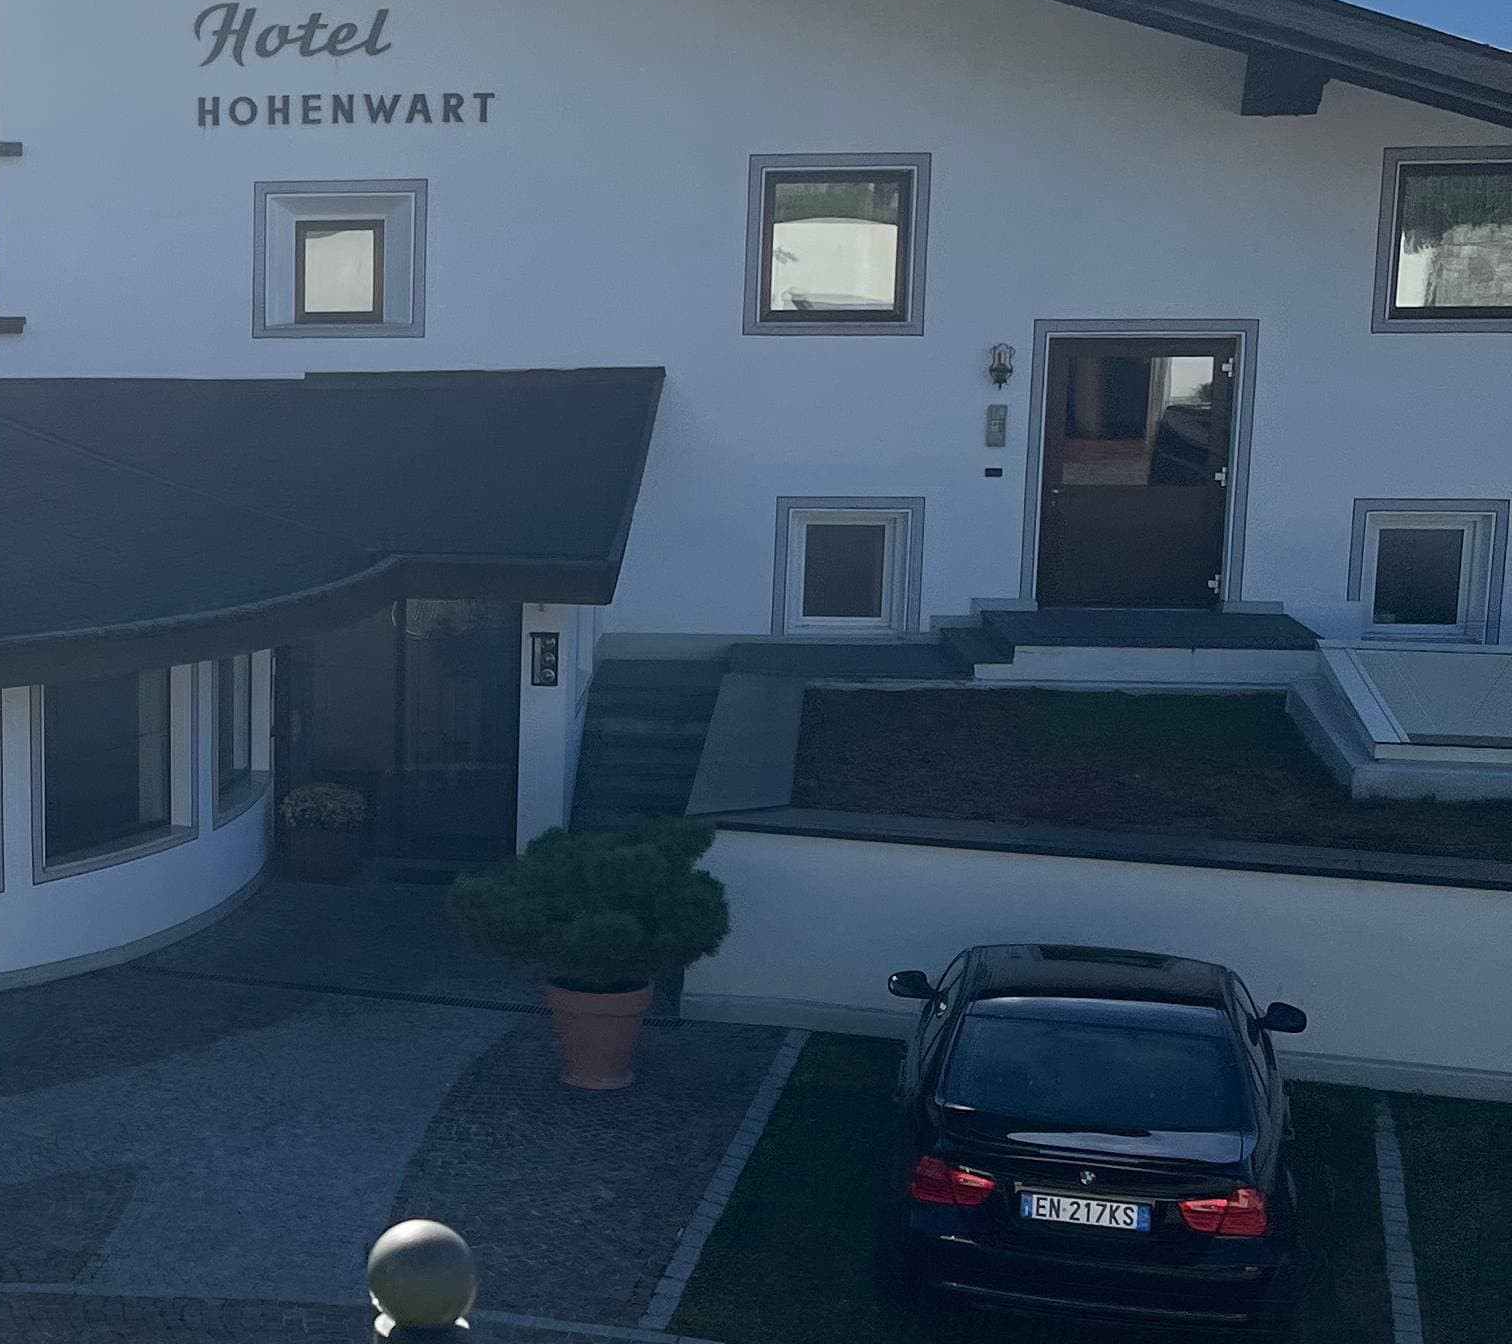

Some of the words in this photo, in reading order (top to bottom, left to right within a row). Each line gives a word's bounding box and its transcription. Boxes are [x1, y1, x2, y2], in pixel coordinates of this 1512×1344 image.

[193, 2, 392, 67] Hotel
[197, 92, 495, 127] HOHENWART
[1035, 1197, 1061, 1219] EN
[1069, 1201, 1135, 1226] 217KS
